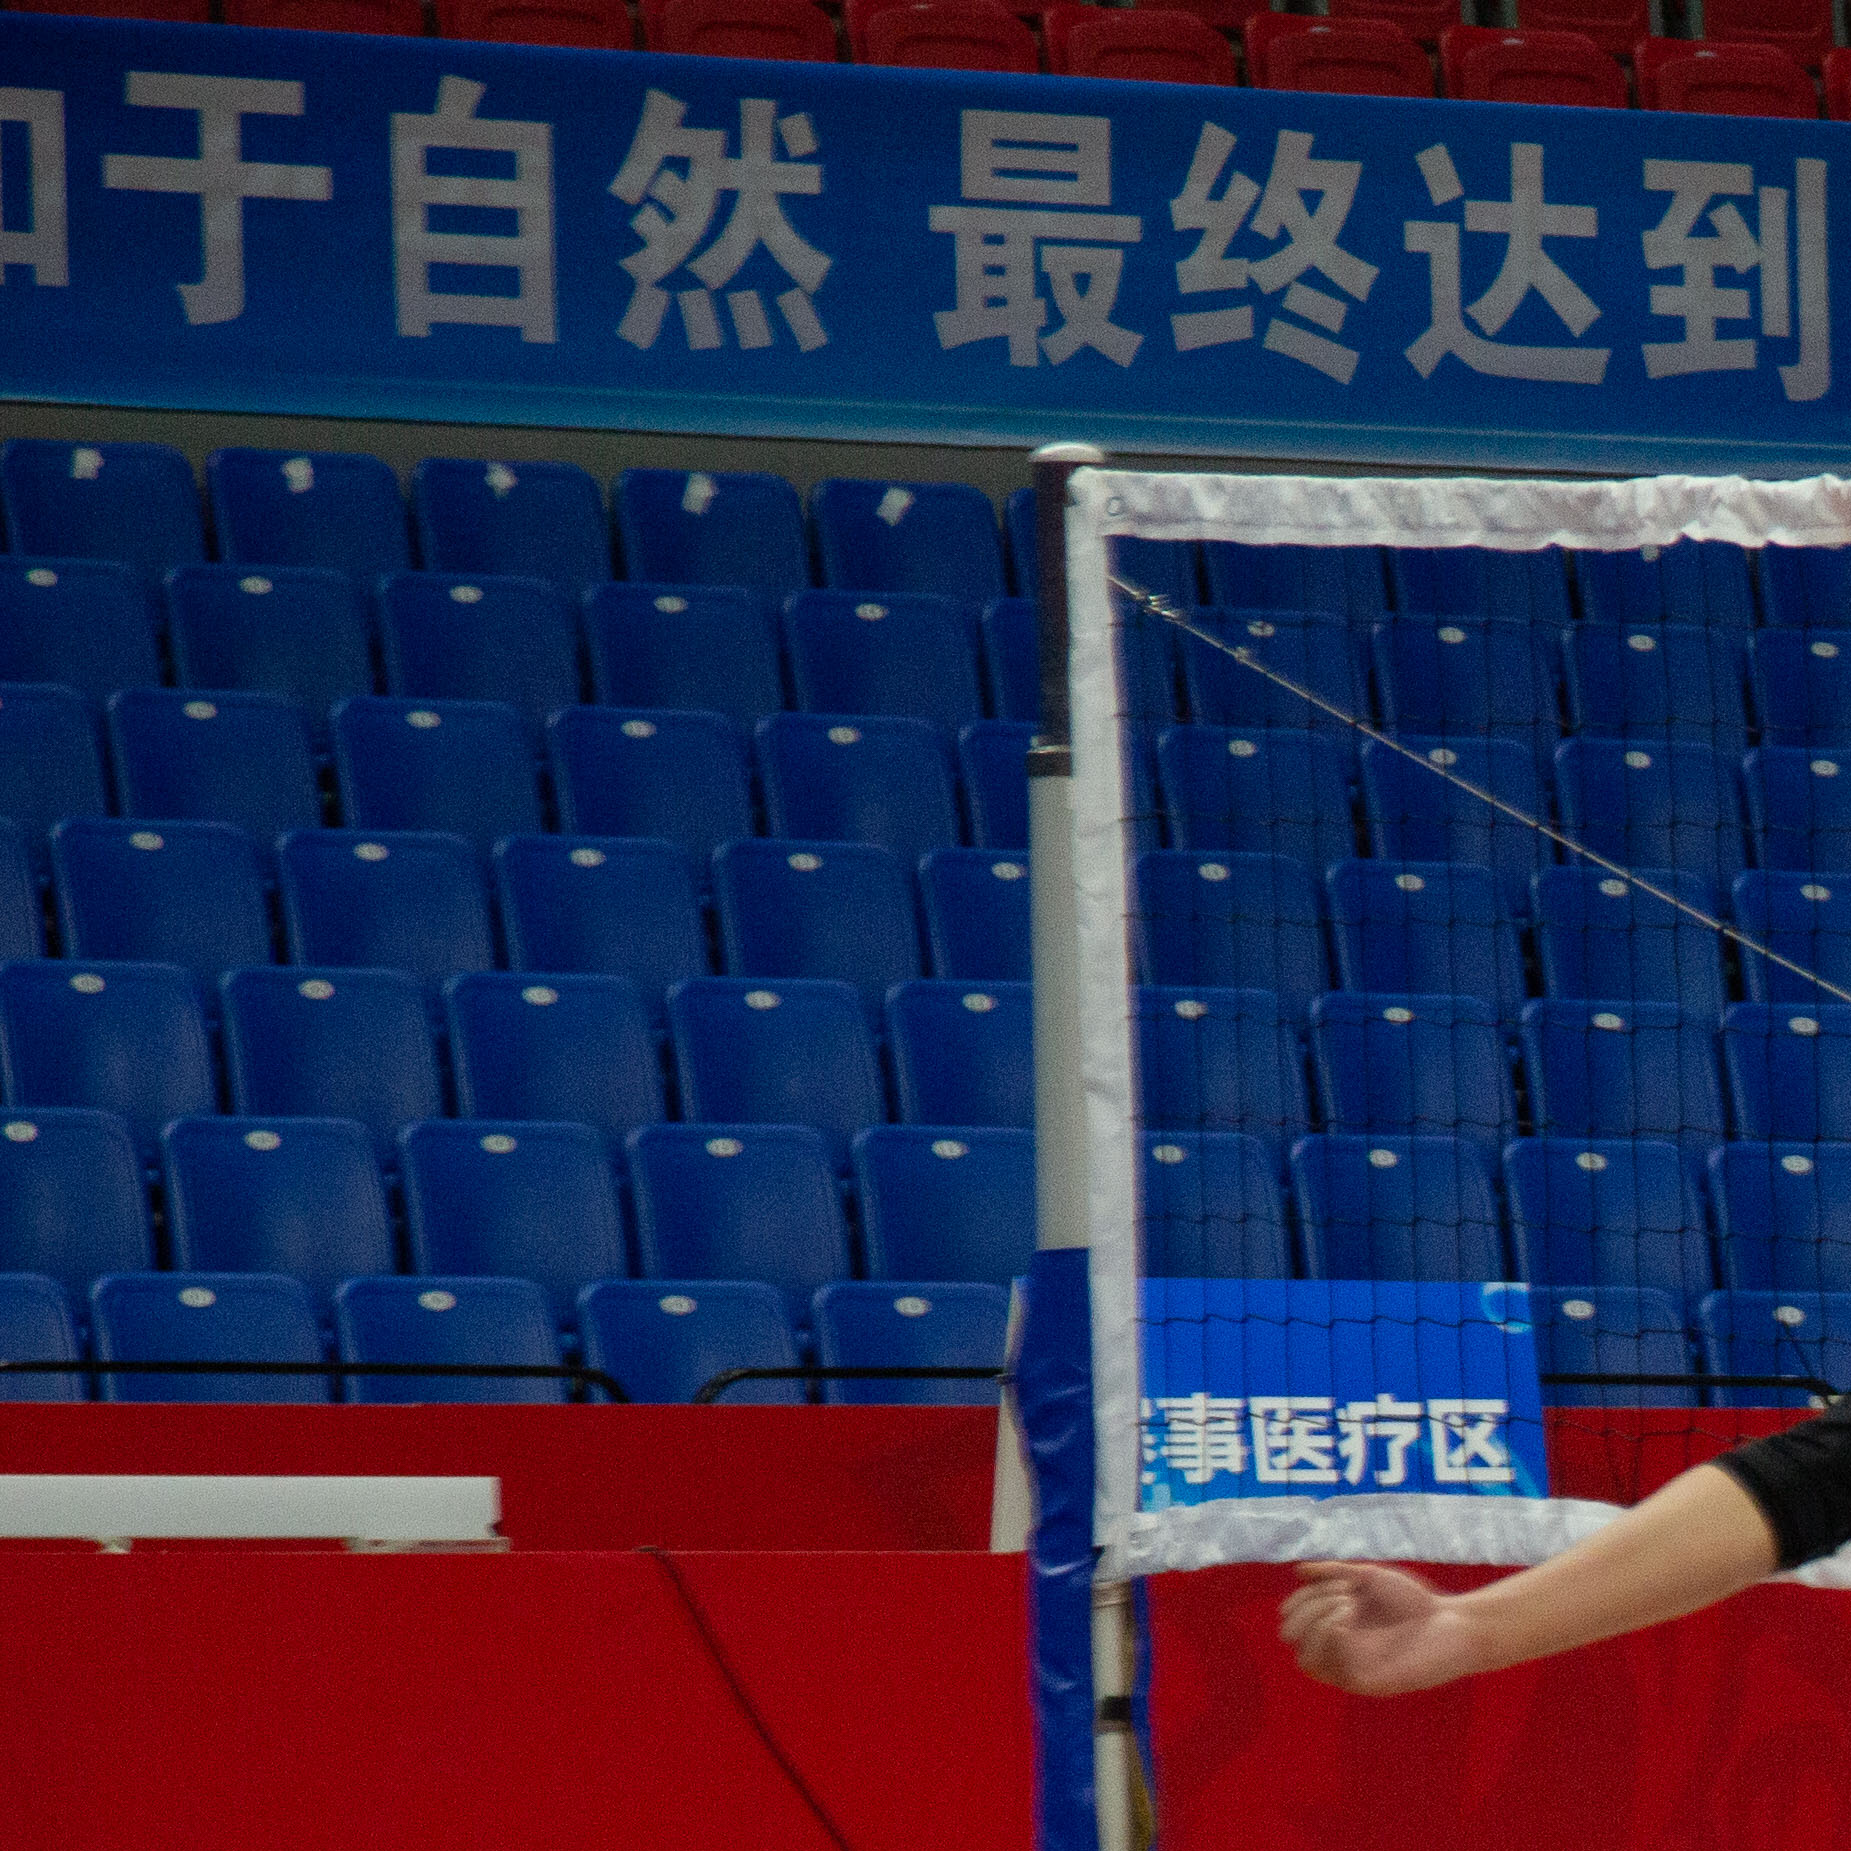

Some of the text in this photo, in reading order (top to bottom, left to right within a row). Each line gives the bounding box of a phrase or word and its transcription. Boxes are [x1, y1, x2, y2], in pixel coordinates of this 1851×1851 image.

[927, 108, 1833, 402] 最终达到
[1140, 1391, 1517, 1485] 事医疗区
